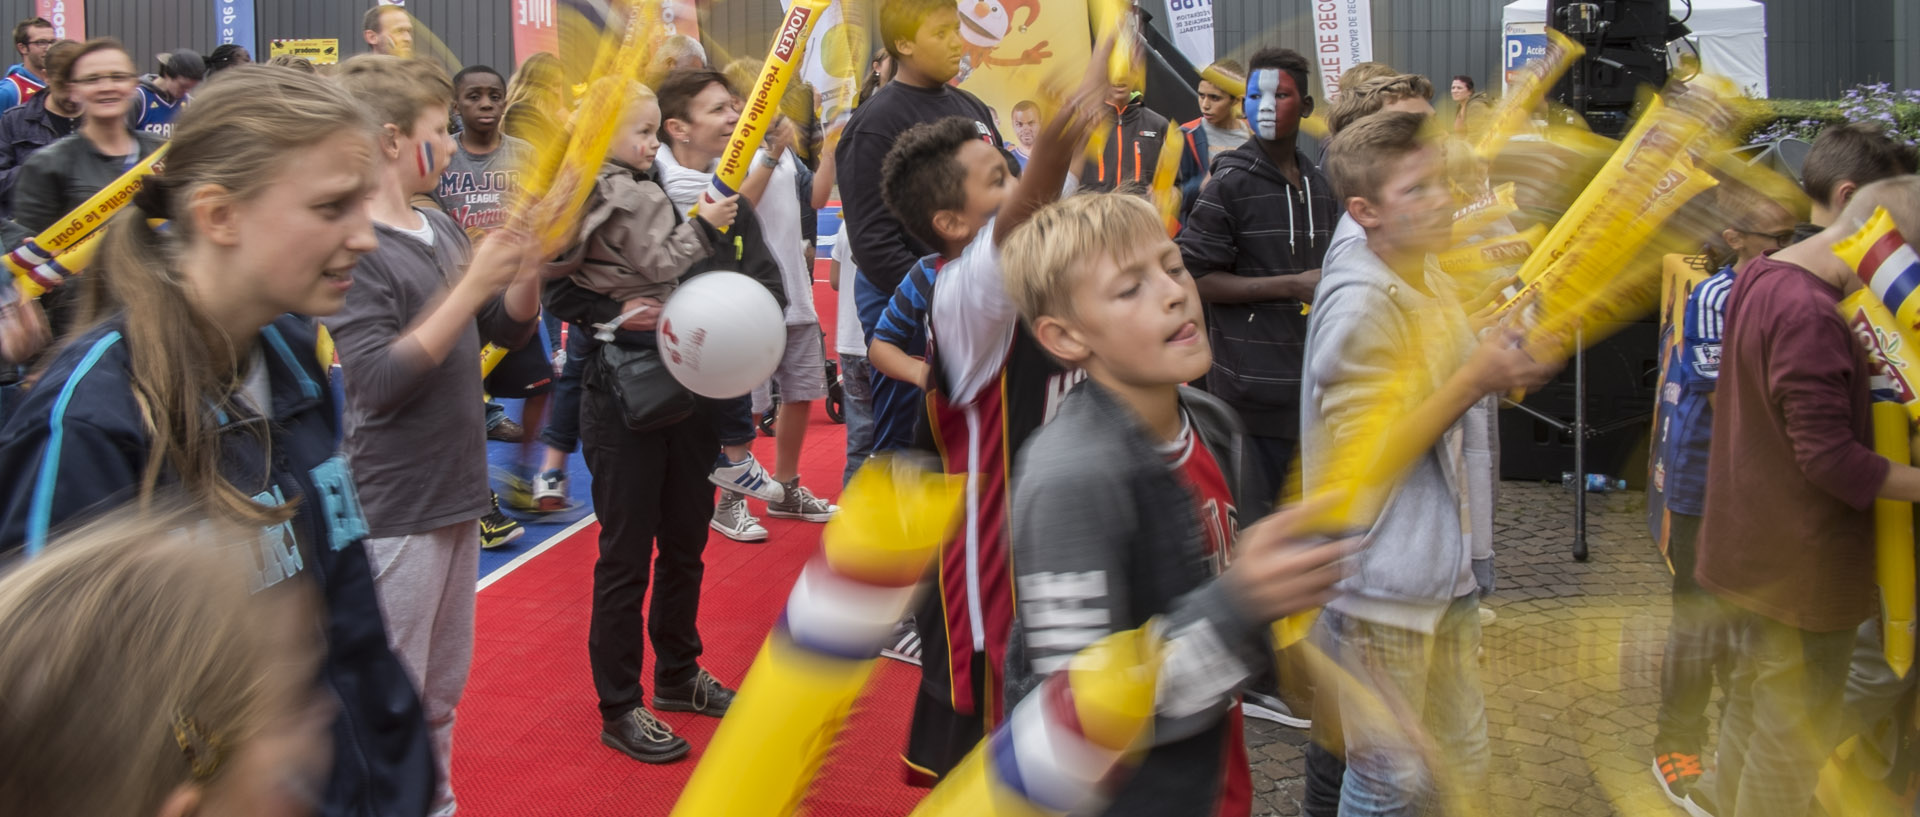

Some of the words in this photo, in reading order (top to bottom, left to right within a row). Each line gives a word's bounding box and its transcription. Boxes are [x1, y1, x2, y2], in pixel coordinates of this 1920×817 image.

[776, 9, 806, 56] JOKER
[1507, 39, 1522, 68] P
[747, 64, 780, 122] réveille
[740, 124, 757, 138] le
[440, 170, 520, 197] MAJOR
[465, 193, 500, 204] LEAGUE
[84, 210, 102, 224] le
